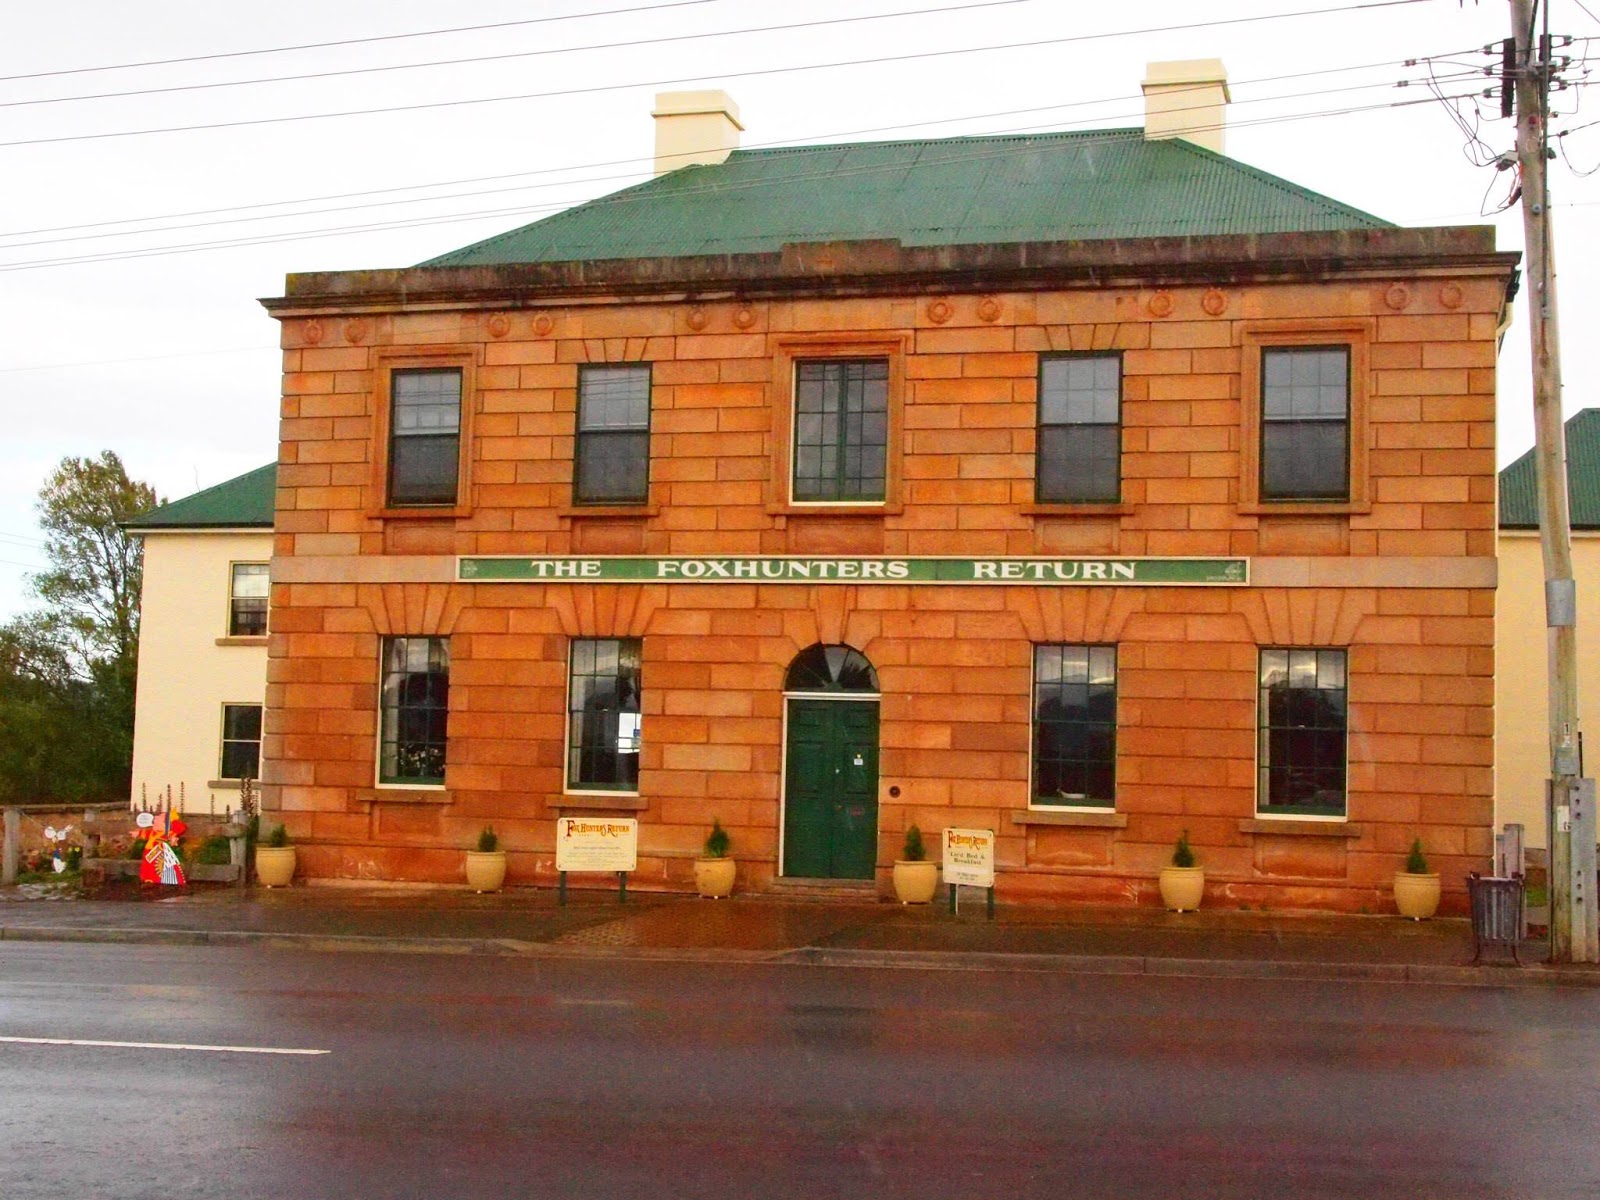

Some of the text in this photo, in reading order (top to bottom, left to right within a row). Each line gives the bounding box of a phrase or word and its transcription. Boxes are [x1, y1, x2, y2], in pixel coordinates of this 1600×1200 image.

[531, 560, 1136, 579] THE FOXHUNTERS RETURN
